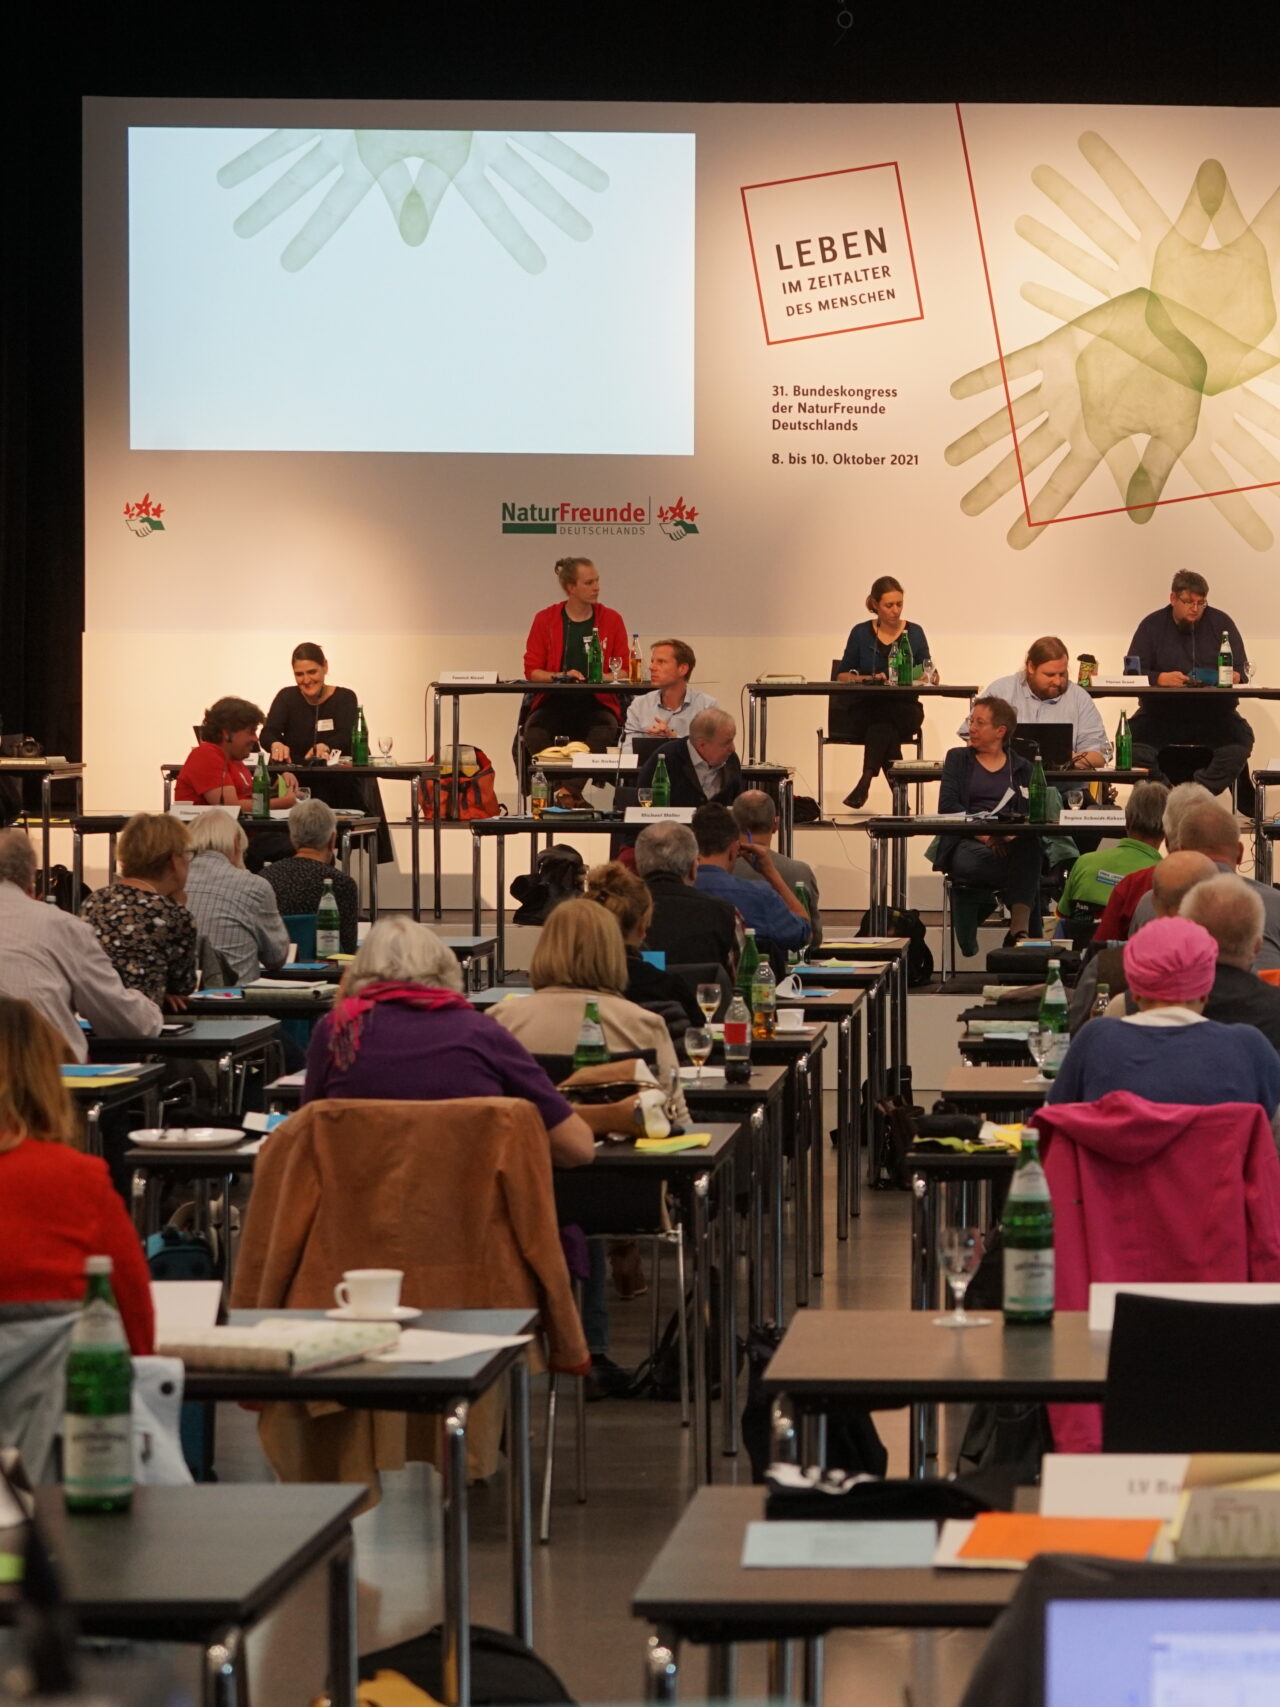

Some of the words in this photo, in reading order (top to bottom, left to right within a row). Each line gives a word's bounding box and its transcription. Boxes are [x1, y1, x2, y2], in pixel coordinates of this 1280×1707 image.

[776, 227, 889, 271] LEBEN
[781, 279, 803, 295] IM
[807, 265, 892, 291] ZEITALTER
[786, 302, 813, 317] DES
[818, 287, 896, 312] MENSCHEN
[772, 385, 789, 397] 31.
[793, 385, 898, 401] Bundeskongress
[772, 402, 793, 414] der
[797, 402, 886, 415] NaturFreunde
[772, 418, 859, 431] Deutschlands
[772, 453, 784, 465] 8.
[788, 453, 807, 465] bis
[811, 453, 829, 465] 10.
[833, 453, 886, 465] Oktober
[890, 453, 919, 465] 2021
[502, 502, 645, 522] NaturFreunde
[559, 526, 646, 536] DEUTSCHLANDS
